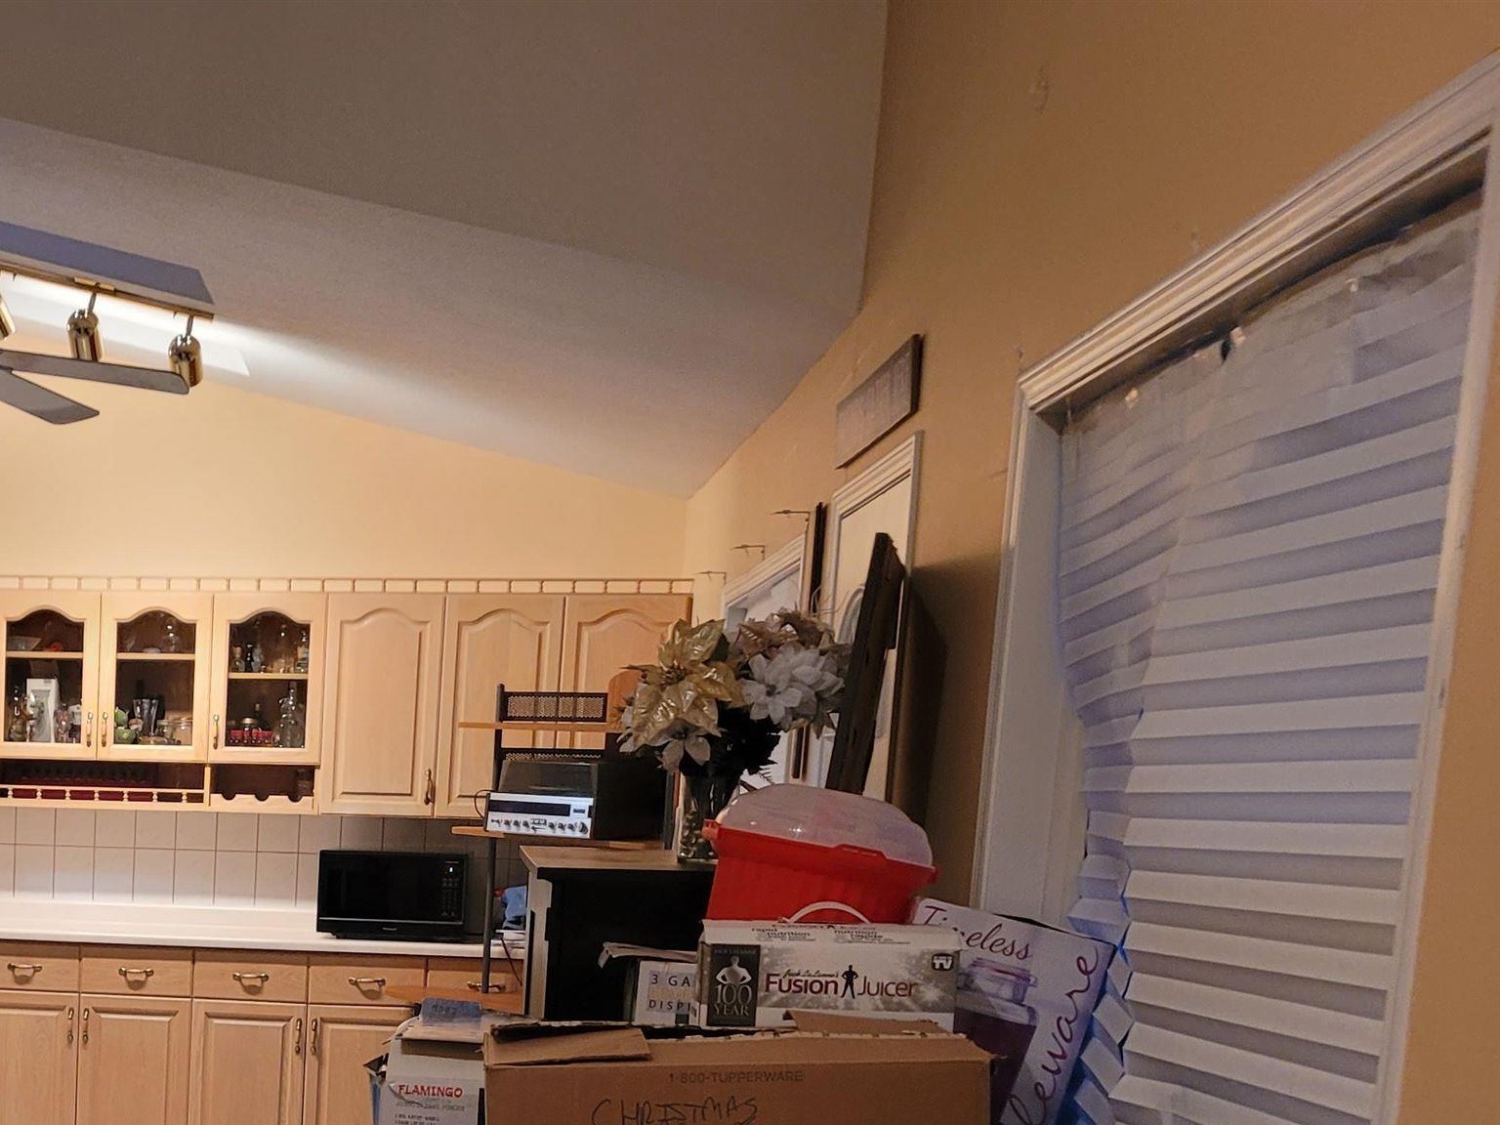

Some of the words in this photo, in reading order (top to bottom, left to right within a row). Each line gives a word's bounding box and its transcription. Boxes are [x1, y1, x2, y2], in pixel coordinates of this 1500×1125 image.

[924, 905, 1032, 961] Teless
[650, 973, 659, 985] 3
[764, 972, 839, 995] Fusion
[857, 975, 919, 998] Juicer
[714, 983, 752, 1005] 100
[713, 1003, 749, 1017] YEAR
[669, 1070, 804, 1084] 1-800-TUPPERWARE
[398, 1084, 463, 1099] FLAMINGO
